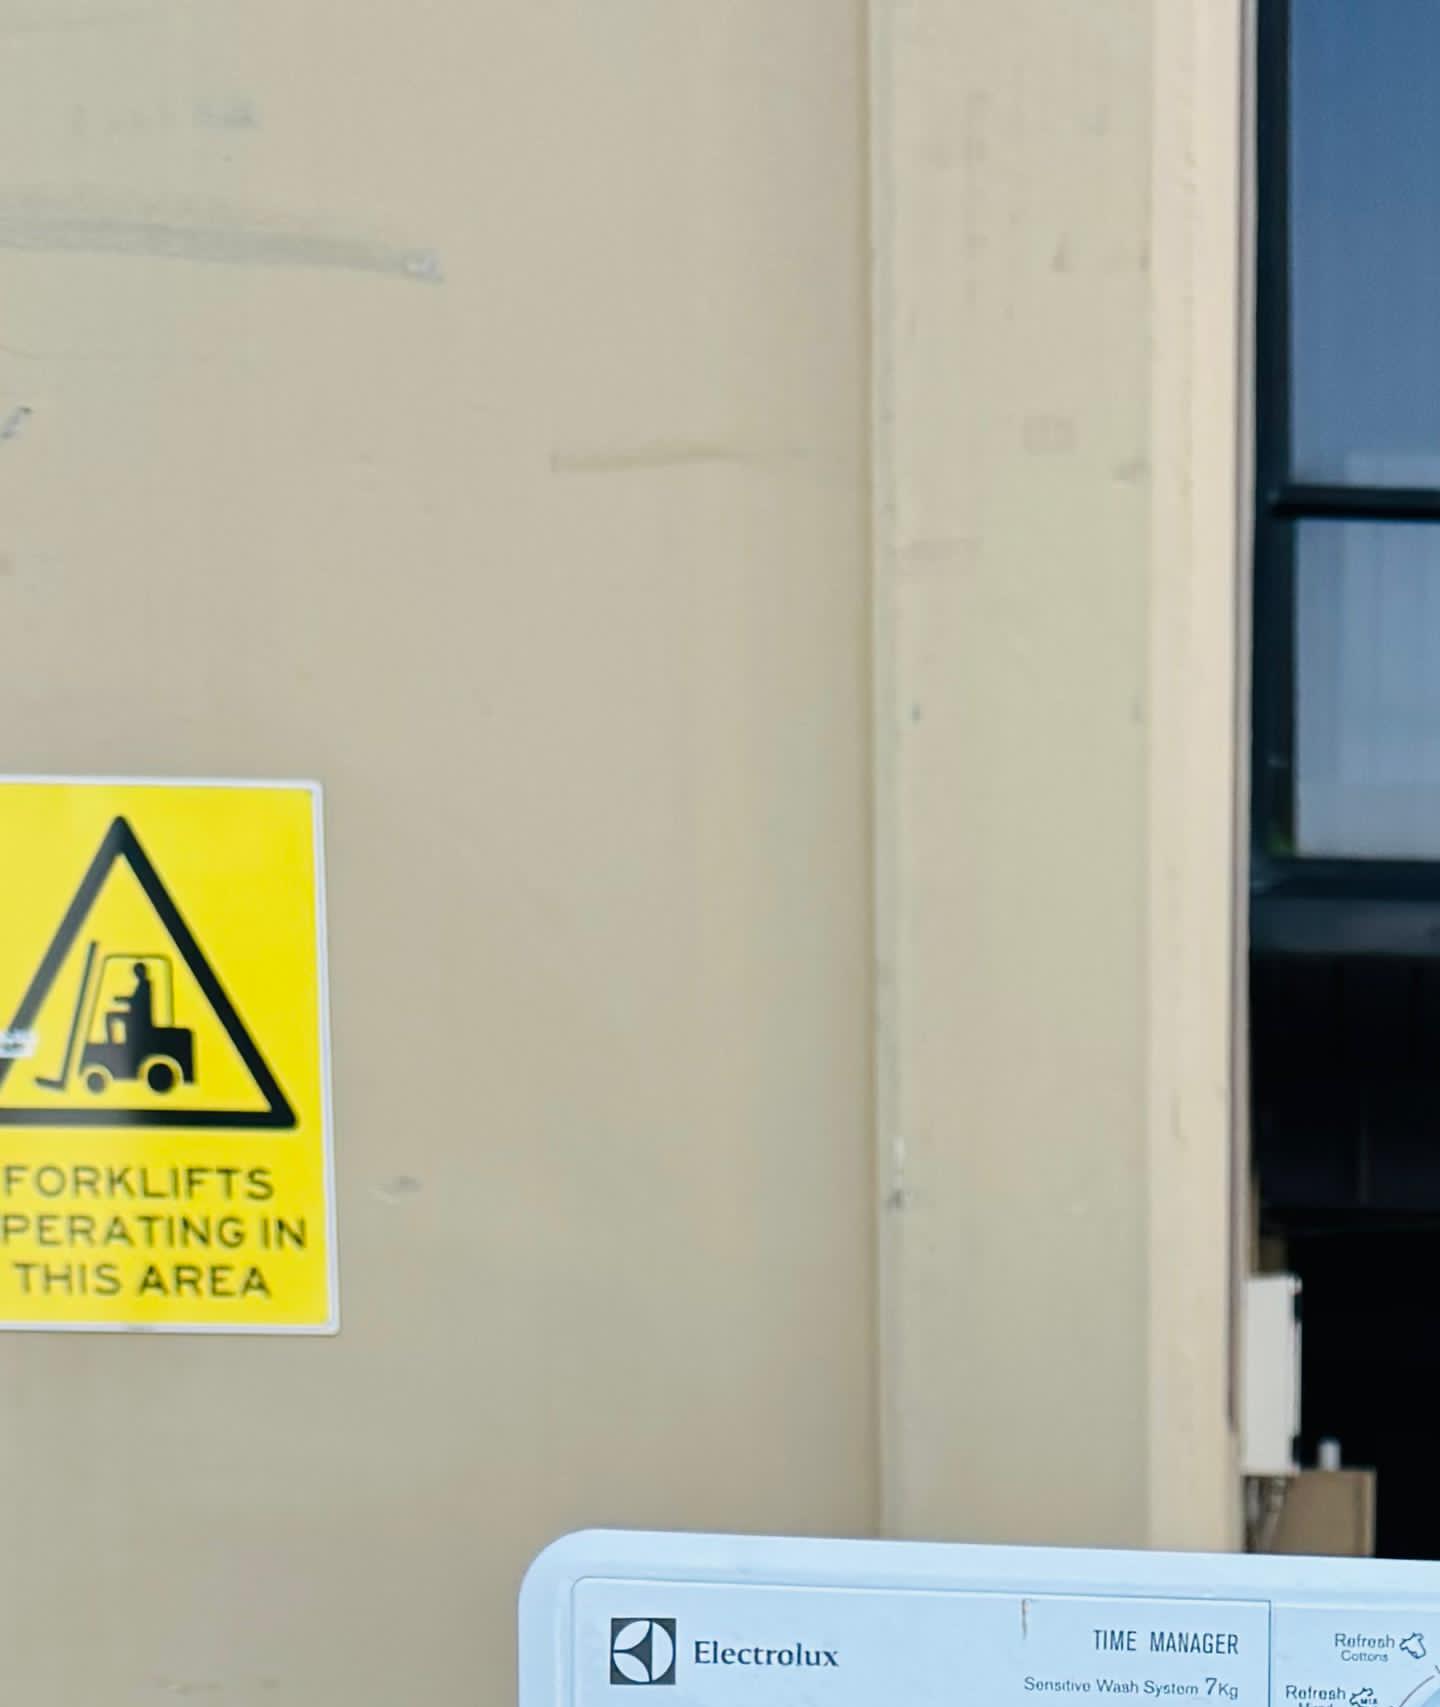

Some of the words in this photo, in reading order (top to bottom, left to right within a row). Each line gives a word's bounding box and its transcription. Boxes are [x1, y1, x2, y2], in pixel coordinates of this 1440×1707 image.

[3, 1164, 275, 1202] FORKLIFTS
[0, 1213, 247, 1249] PERATING
[262, 1217, 307, 1250] IN
[13, 1262, 122, 1297] THIS
[138, 1264, 271, 1298] AREA
[693, 1640, 839, 1667] Electrolux
[1092, 1629, 1137, 1652] TIME
[1149, 1631, 1239, 1655] MANAGER
[1334, 1632, 1395, 1649] Refresh
[1339, 1649, 1389, 1663] Cottons
[1023, 1676, 1091, 1693] Sensitive
[1096, 1678, 1138, 1694] Wash
[1143, 1680, 1199, 1698] System
[1285, 1685, 1346, 1702] Refresh
